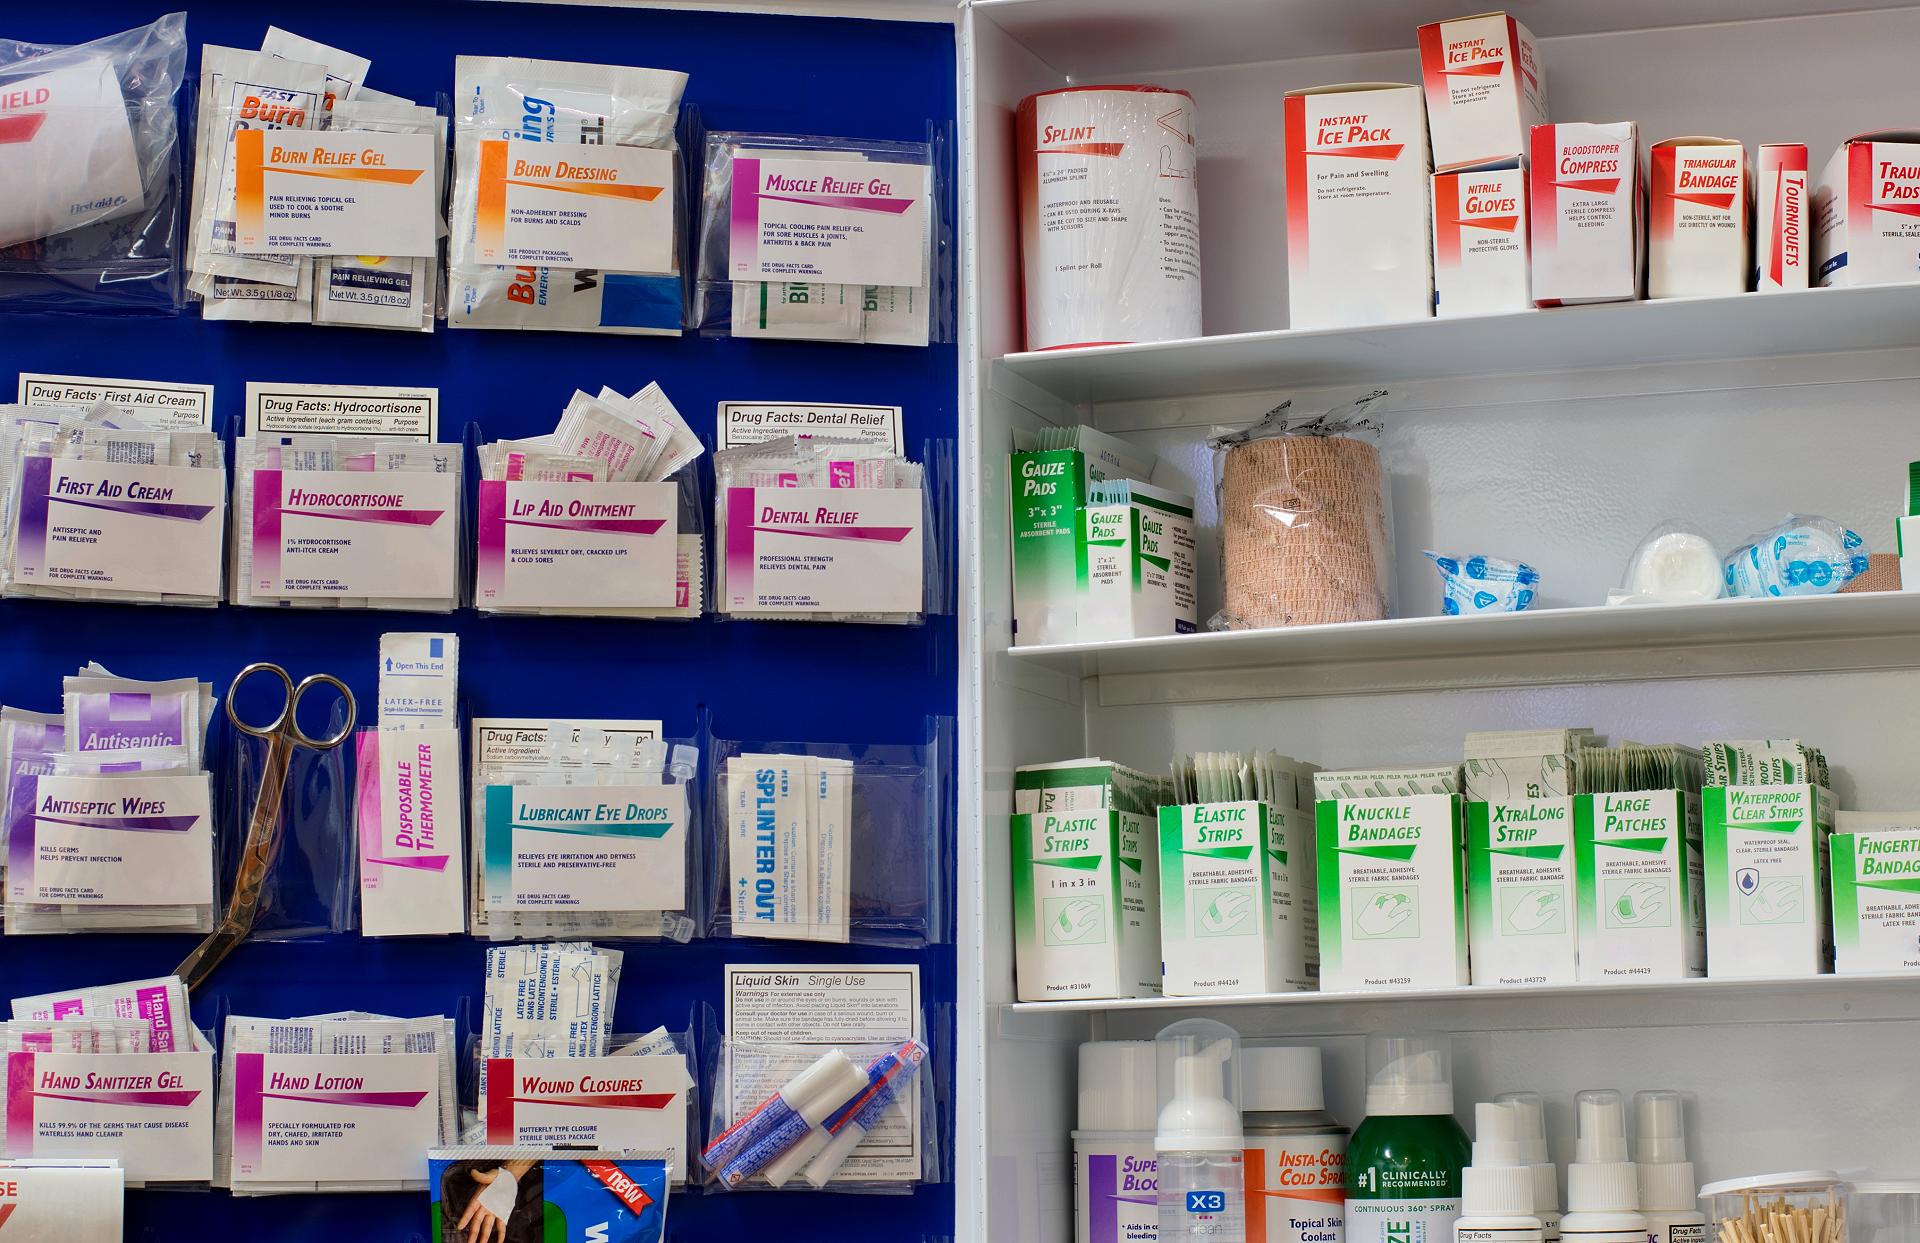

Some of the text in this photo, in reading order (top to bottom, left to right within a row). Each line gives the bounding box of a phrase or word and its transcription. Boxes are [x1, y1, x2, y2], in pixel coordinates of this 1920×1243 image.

[1449, 39, 1486, 51] INSTANT
[1319, 114, 1368, 127] INSTANT
[1562, 144, 1620, 156] BLOODSTOPPER
[1683, 159, 1736, 169] TRIANGULAR
[1360, 169, 1389, 177] Swelling
[1468, 183, 1503, 194] NITRILE
[511, 209, 587, 218] NON-ADHERENT DRESSING
[764, 222, 788, 230] TOPICAL
[332, 273, 410, 286] PAIN RELIEVING GEL
[265, 399, 422, 415] Drug Facts: Hydrocortisone
[731, 411, 885, 426] Drug Facts: Dental Relief
[395, 662, 444, 671] Open This End
[384, 698, 443, 706] LATEX-FREE
[755, 878, 775, 923] OUT
[735, 975, 866, 988] Liquid Skin Single Use
[1070, 982, 1091, 990] #31069
[517, 979, 527, 1020] LATEX FREE
[735, 990, 769, 998] Warnings
[1358, 1166, 1376, 1193] #1
[1382, 1171, 1447, 1180] CLINICALLY
[608, 1172, 643, 1205] new
[1191, 1195, 1221, 1209] X3
[1354, 1205, 1404, 1213] CONTINUOUS
[1430, 1204, 1456, 1212] SPRAY
[1289, 1217, 1343, 1231] Topical Skin
[1301, 1232, 1336, 1242] Coolant
